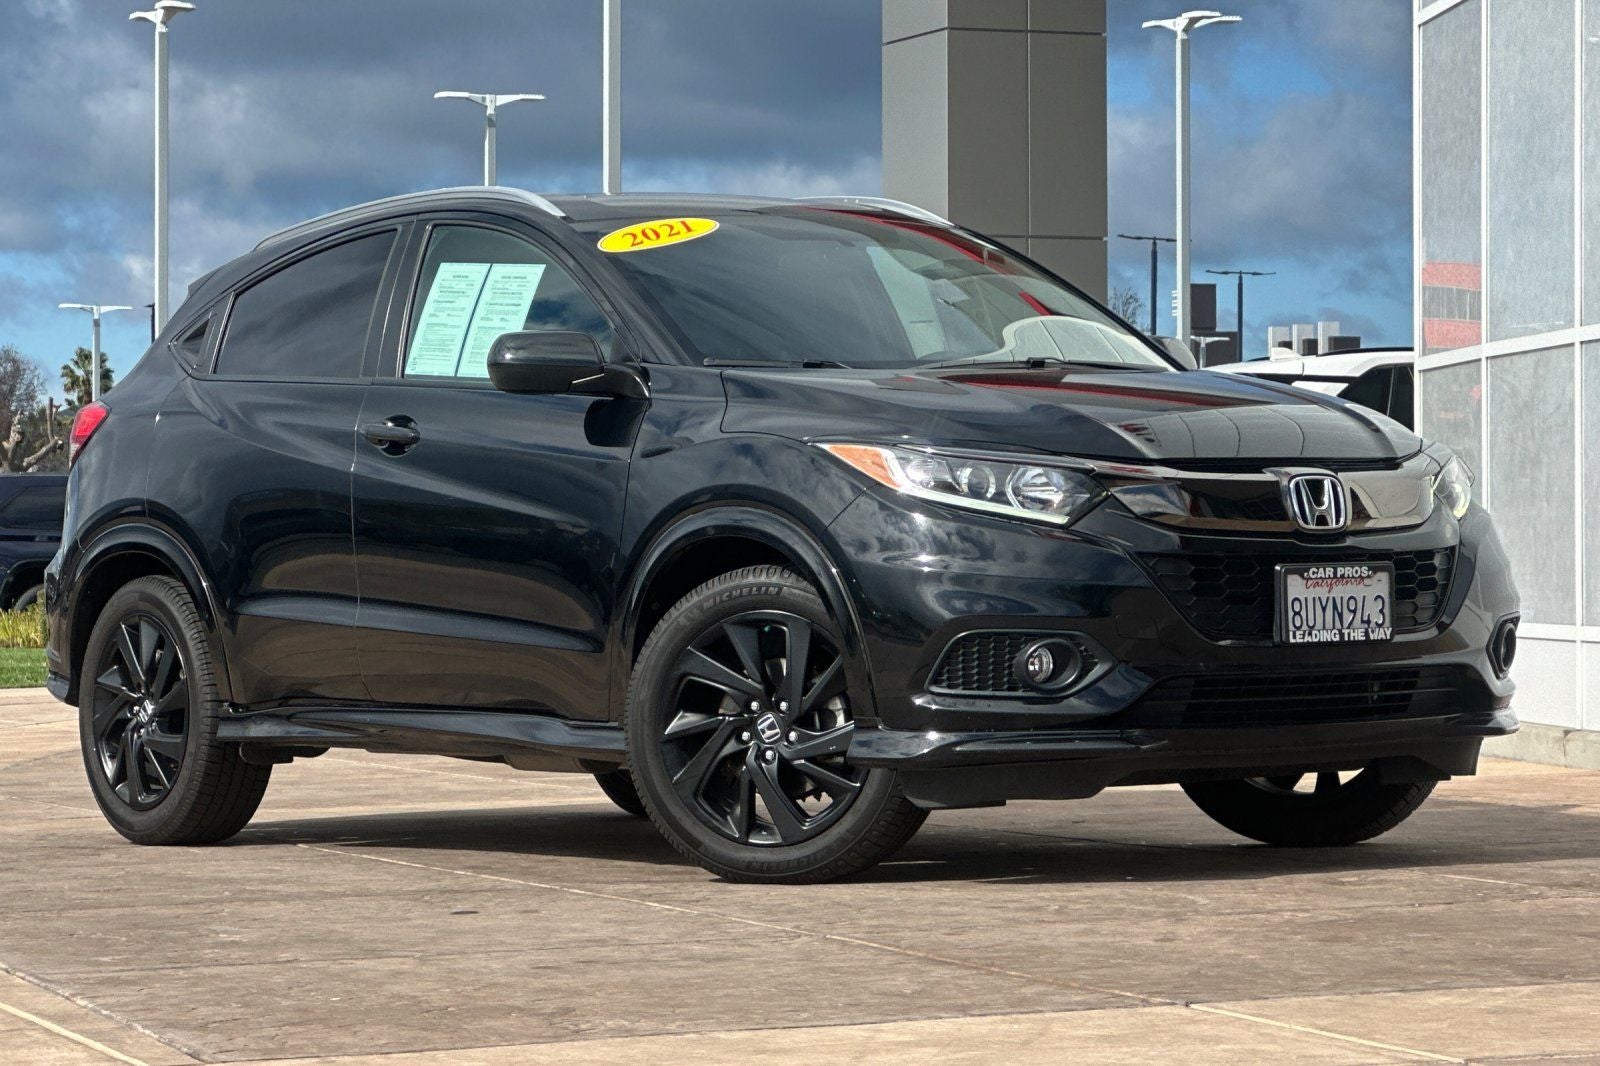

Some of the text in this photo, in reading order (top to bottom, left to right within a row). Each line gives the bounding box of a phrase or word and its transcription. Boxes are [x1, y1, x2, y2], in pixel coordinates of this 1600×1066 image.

[622, 220, 694, 247] 2021
[1309, 566, 1369, 579] CAR PROS
[703, 586, 778, 609] MICHELIN
[1291, 594, 1386, 630] 8UYN943
[1289, 627, 1393, 643] LEADING THE WAY
